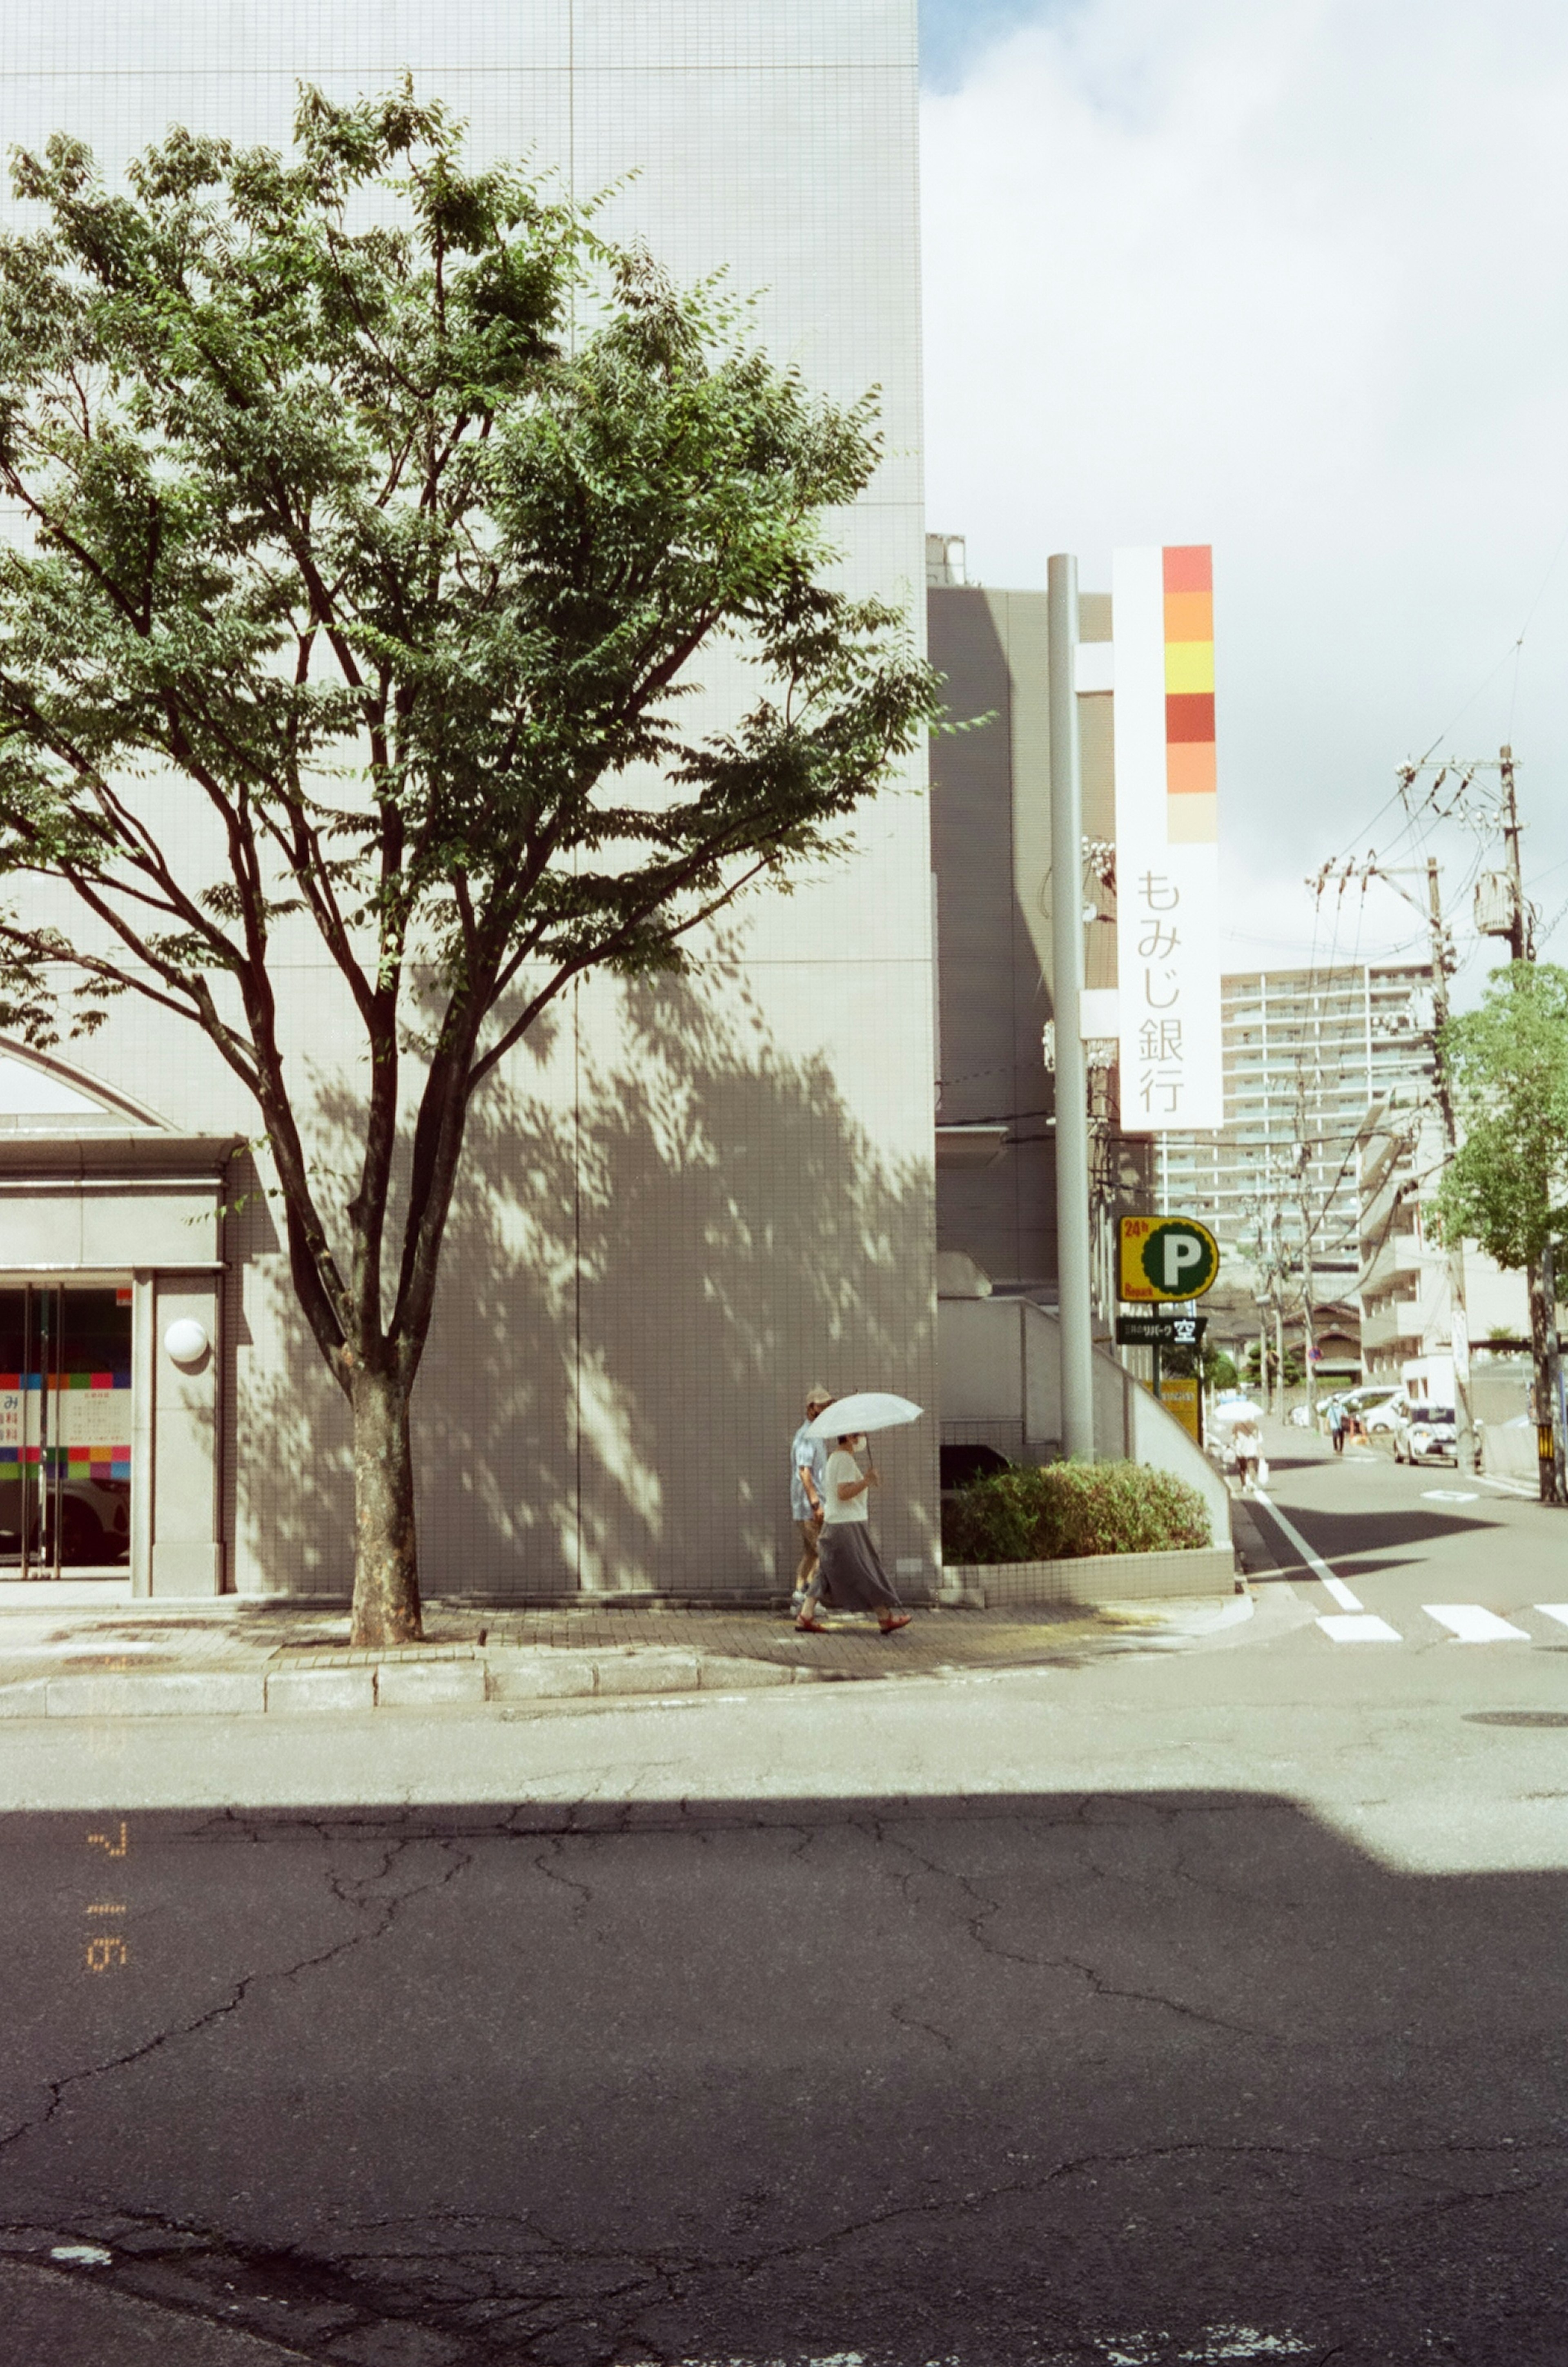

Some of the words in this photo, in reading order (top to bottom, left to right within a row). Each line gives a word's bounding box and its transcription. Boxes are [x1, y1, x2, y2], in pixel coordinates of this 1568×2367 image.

[1138, 869, 1184, 1112] もみじ銀行
[1163, 1234, 1202, 1286] P
[1174, 1319, 1196, 1343] 空
